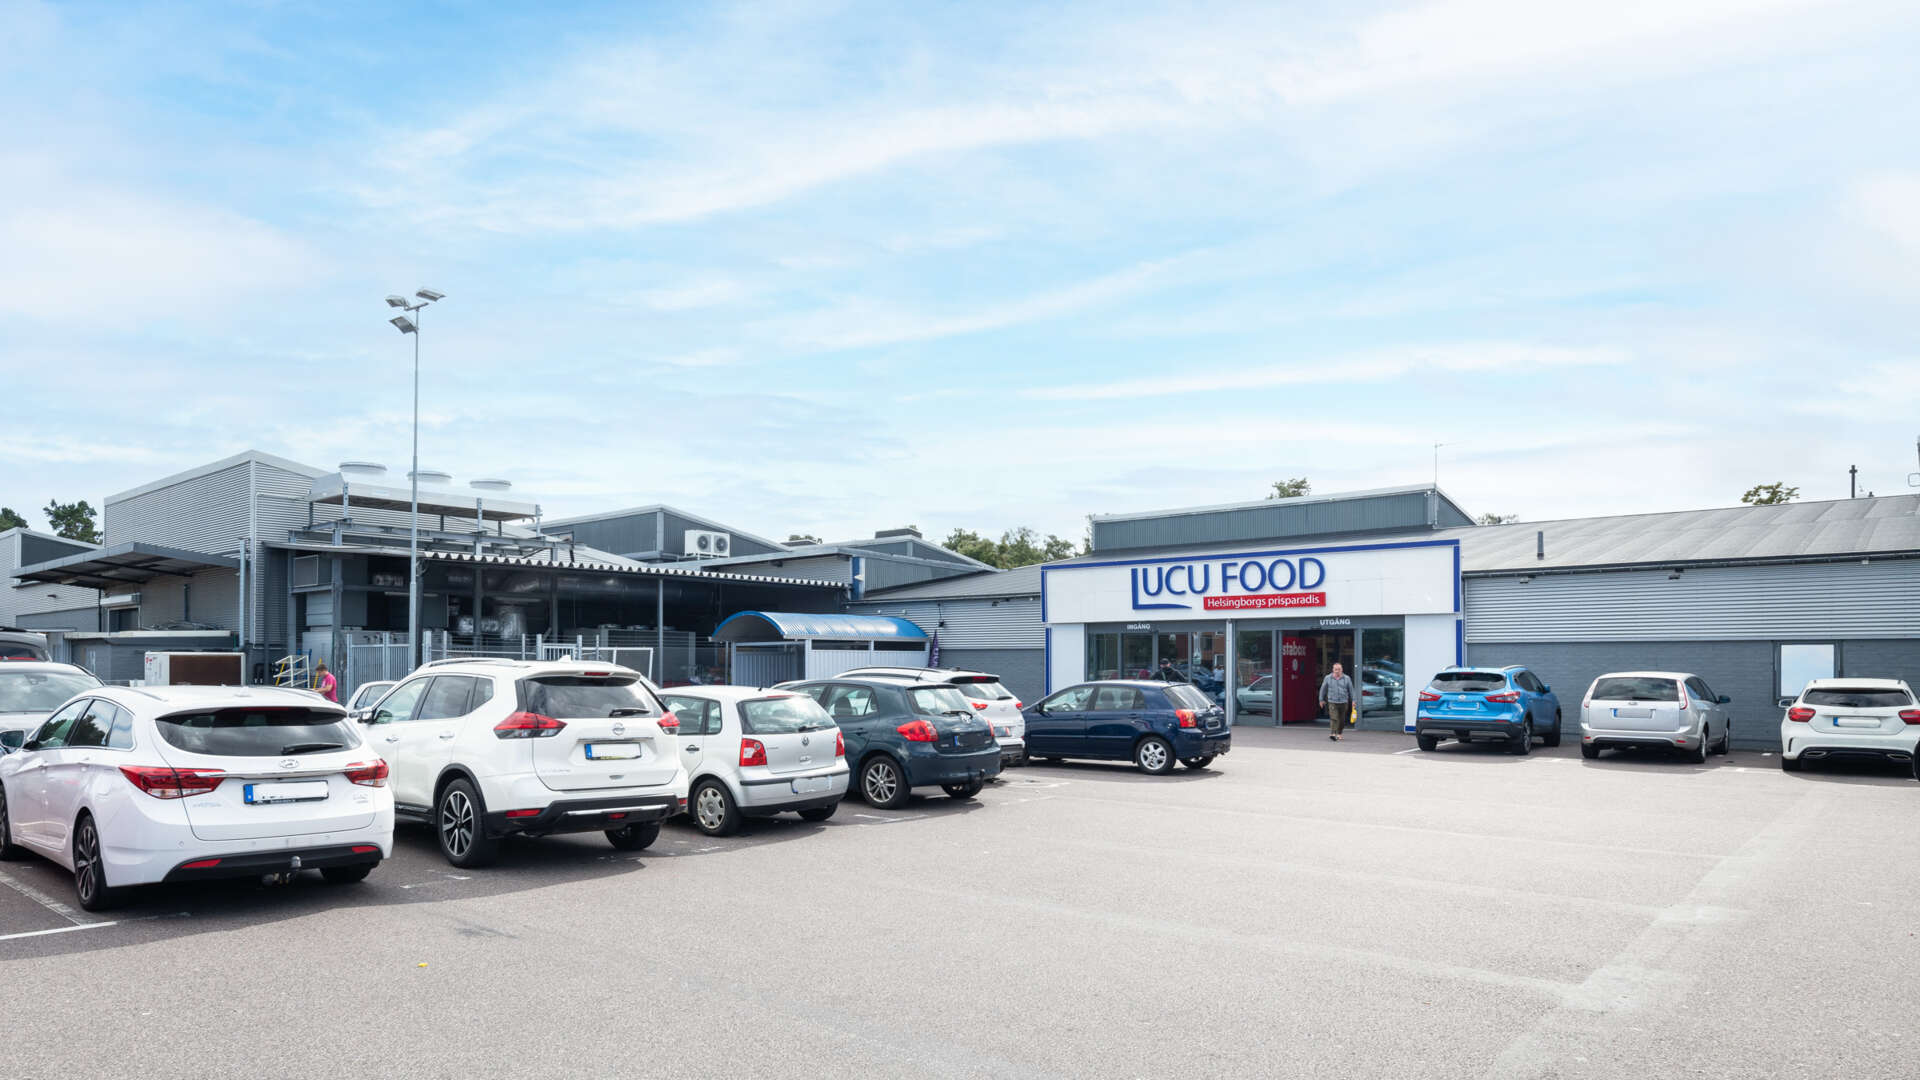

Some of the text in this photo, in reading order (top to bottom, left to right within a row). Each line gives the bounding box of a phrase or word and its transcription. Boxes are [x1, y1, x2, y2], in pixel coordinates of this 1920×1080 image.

[1131, 557, 1326, 610] LUCU FOOD
[1207, 595, 1320, 609] Helsingborgs prisparadis
